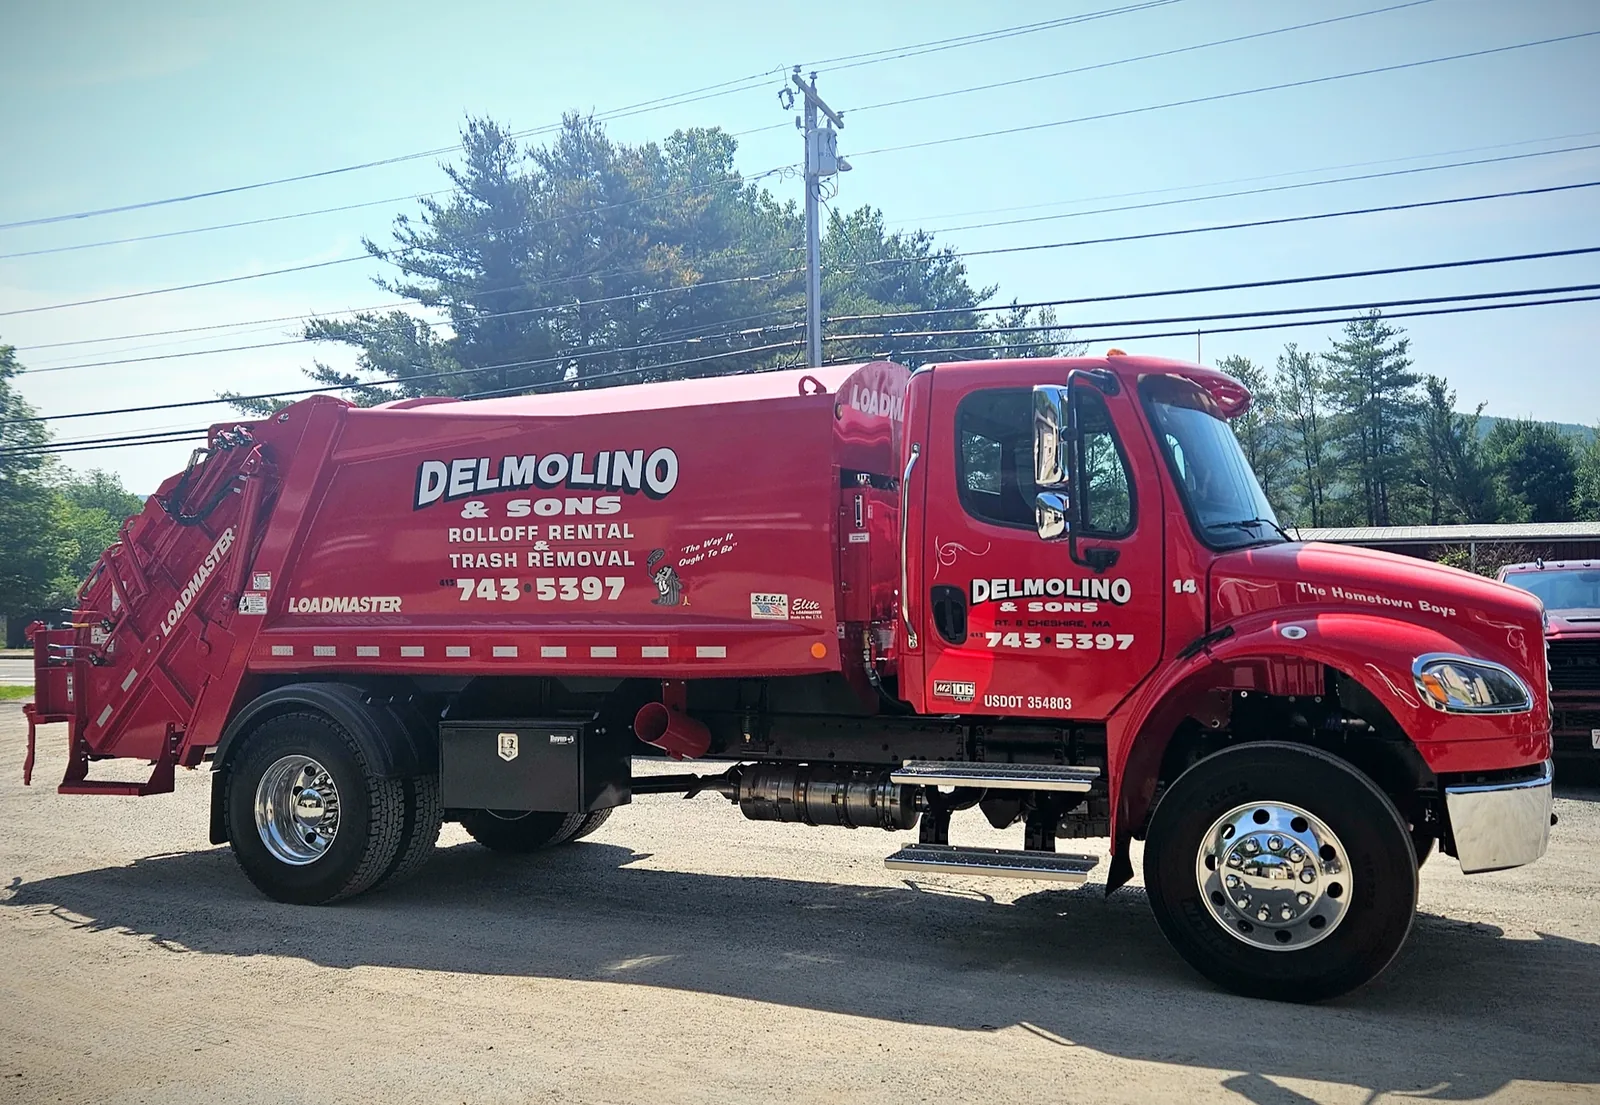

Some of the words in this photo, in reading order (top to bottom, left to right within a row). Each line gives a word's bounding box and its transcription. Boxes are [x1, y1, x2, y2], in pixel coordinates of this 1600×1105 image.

[413, 447, 680, 511] DELMOLINO
[460, 500, 489, 519] &
[506, 495, 622, 518] SONS
[448, 525, 538, 543] ROLLOFF
[548, 523, 635, 541] RENTAL
[703, 537, 723, 548] Way
[725, 532, 734, 541] It
[533, 540, 550, 551] &
[449, 553, 518, 569] TRASH
[527, 550, 636, 568] REMOVAL
[678, 553, 705, 567] Ought
[708, 549, 718, 558] To
[159, 526, 236, 638] LOADMASTER
[1172, 579, 1197, 593] 14
[970, 577, 1132, 605] DELMOLINO
[288, 596, 402, 613] LOADMASTER
[792, 598, 820, 611] Elite
[999, 601, 1018, 613] &
[1027, 601, 1099, 613] SONS
[1296, 582, 1327, 596] The
[1331, 586, 1413, 609] Hometown
[1418, 600, 1457, 618] Boys
[994, 619, 1011, 627] RT.
[1027, 619, 1087, 628] CHESHIRE,
[1091, 620, 1111, 628] MA
[937, 684, 950, 693] M2
[952, 683, 974, 695] 106
[984, 694, 1024, 709] USDOT
[1028, 696, 1072, 711] 354803
